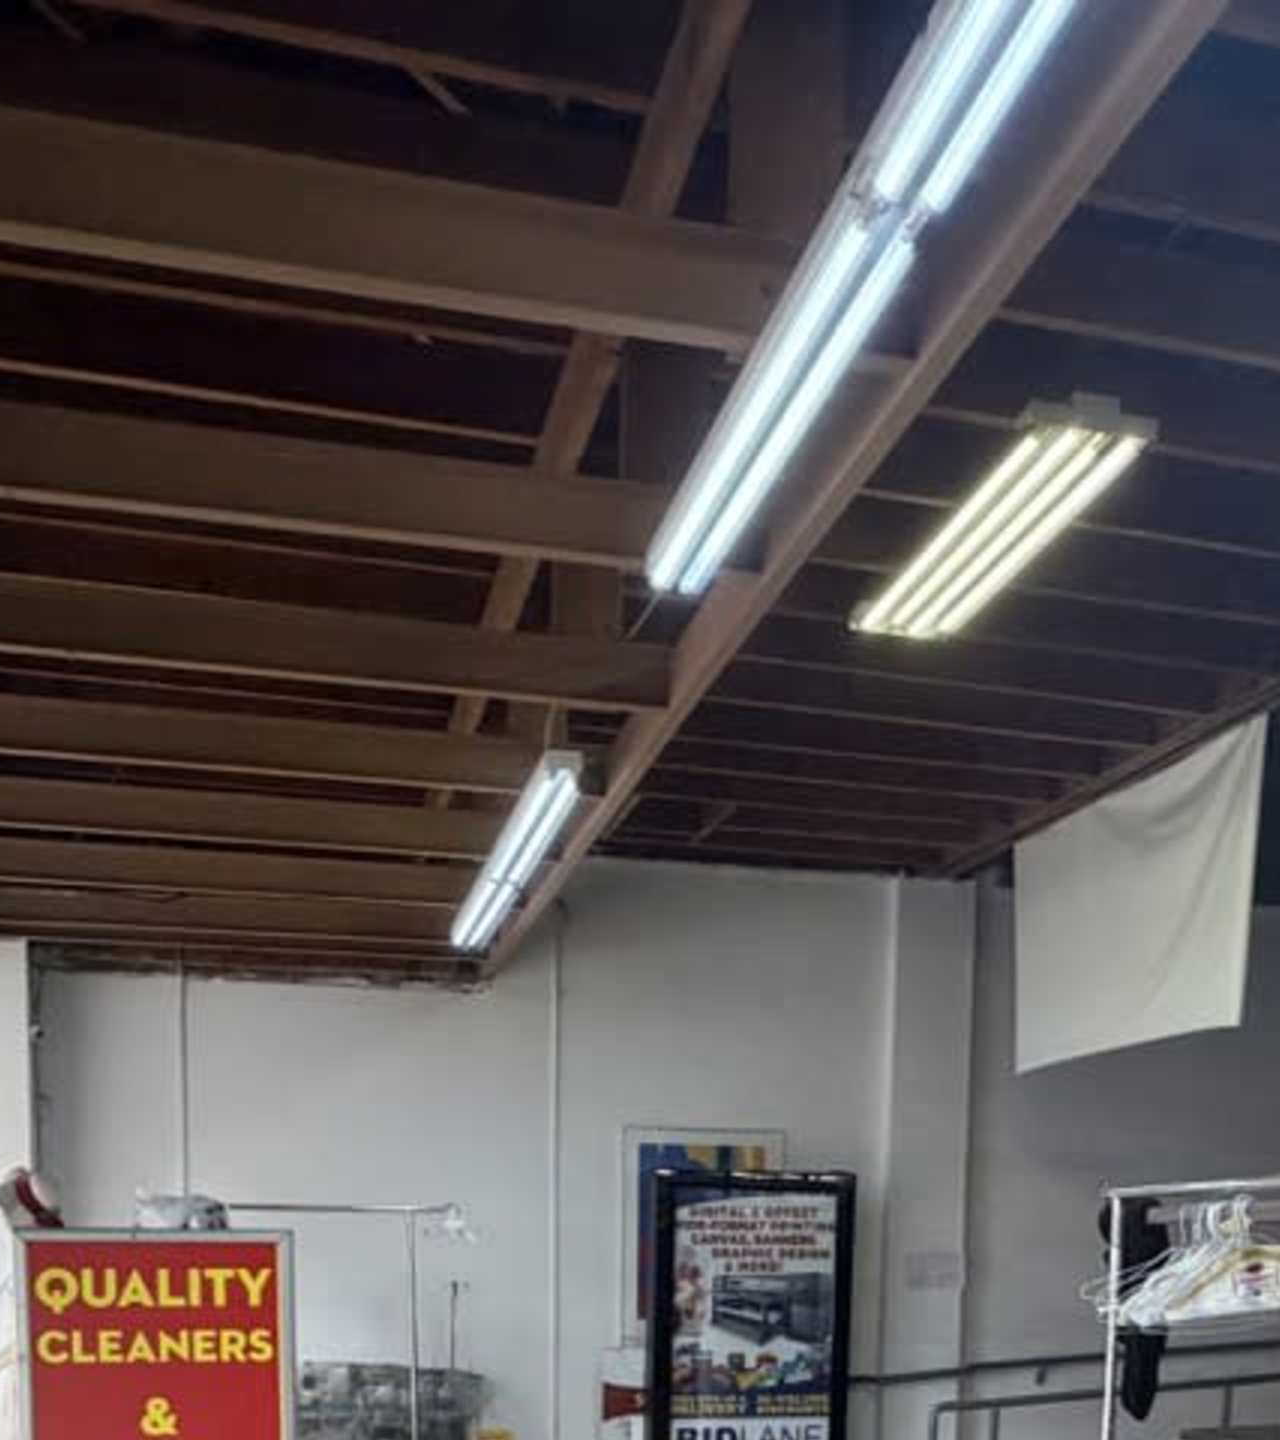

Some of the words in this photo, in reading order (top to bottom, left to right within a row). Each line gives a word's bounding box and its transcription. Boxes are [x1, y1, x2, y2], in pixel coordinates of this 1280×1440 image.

[34, 1266, 272, 1314] QUALITY
[35, 1329, 274, 1364] CLEANERS
[140, 1395, 178, 1436] &
